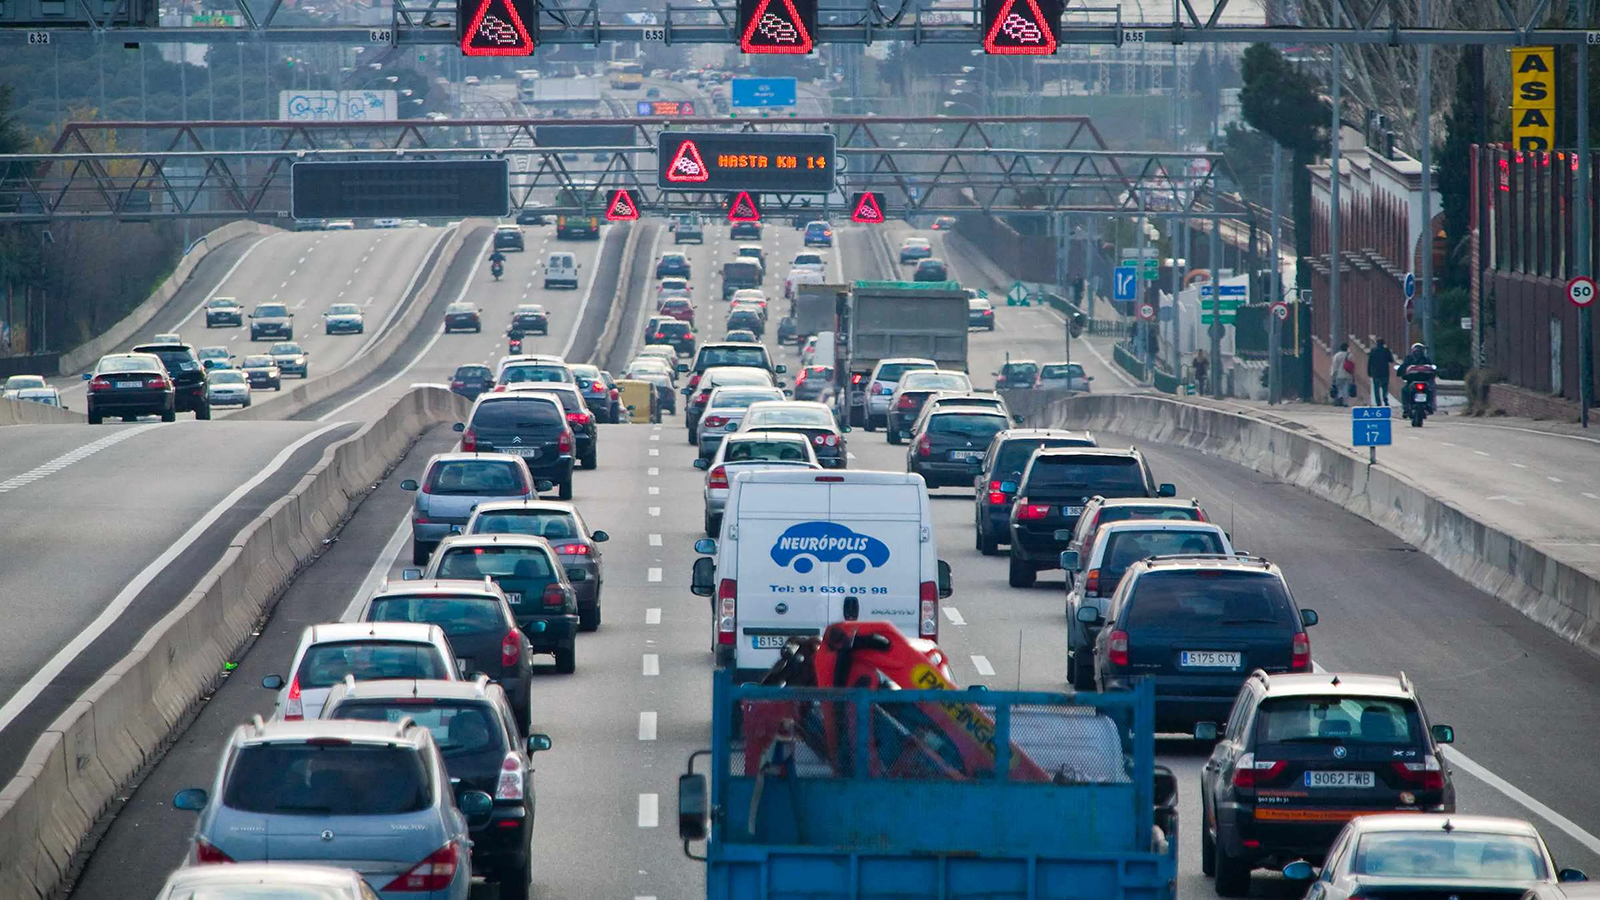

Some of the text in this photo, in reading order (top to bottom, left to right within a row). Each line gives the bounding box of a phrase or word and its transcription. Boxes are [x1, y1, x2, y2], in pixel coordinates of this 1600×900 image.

[718, 155, 826, 169] HASTA KM 14
[1573, 286, 1591, 297] 50
[1362, 409, 1382, 418] A-6
[1366, 431, 1380, 443] 17
[780, 534, 869, 551] NEURÓPOLIS
[769, 585, 795, 593] Tel:
[820, 586, 845, 594] 636
[759, 636, 784, 647] 6153
[1190, 653, 1237, 664] 5175 CTX
[1314, 773, 1371, 785] 9062 FWB
